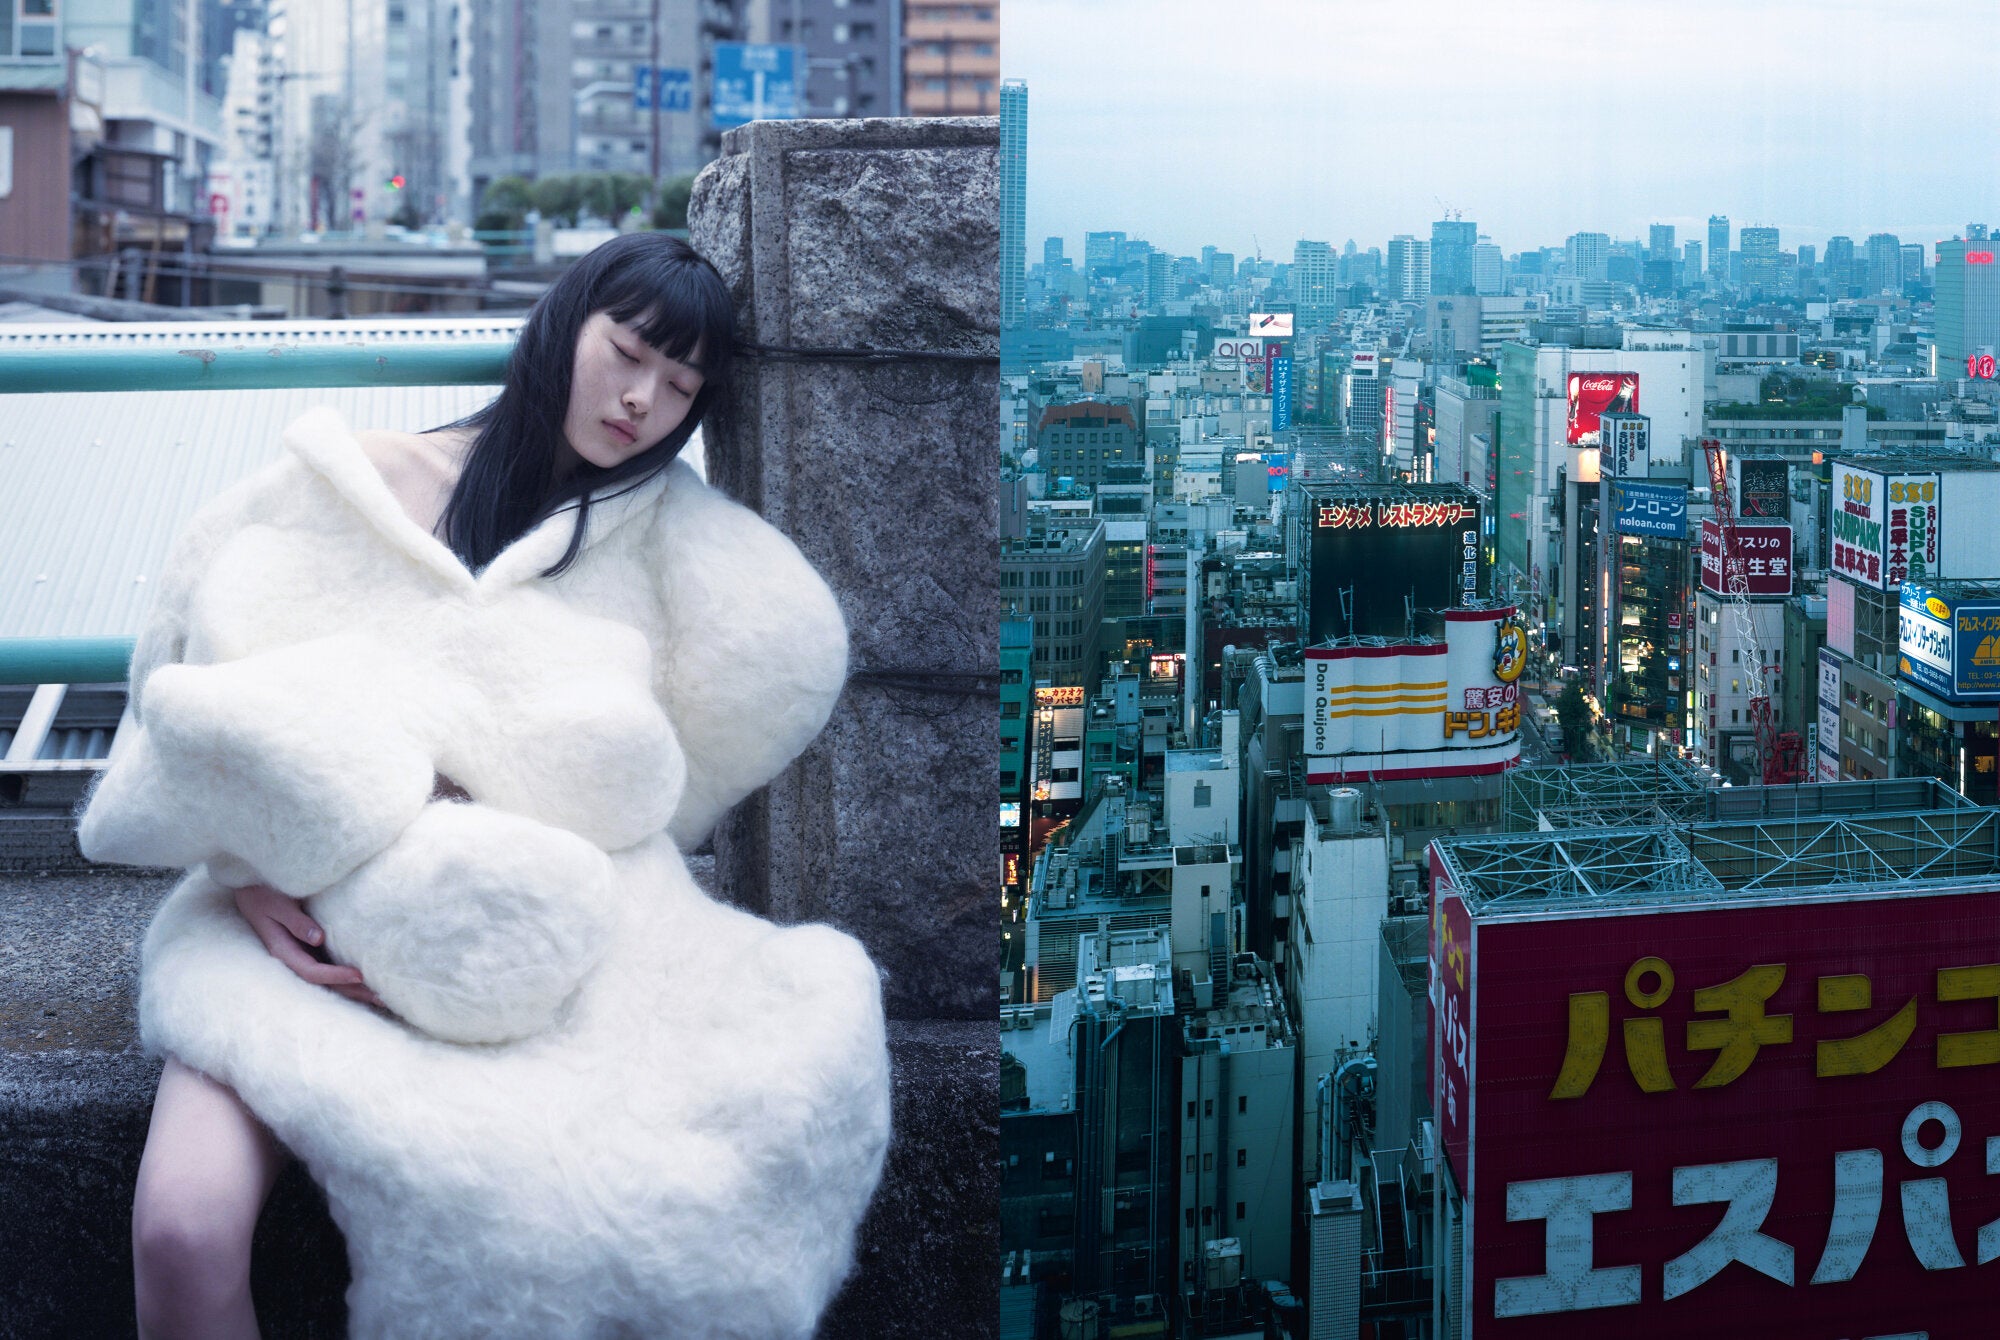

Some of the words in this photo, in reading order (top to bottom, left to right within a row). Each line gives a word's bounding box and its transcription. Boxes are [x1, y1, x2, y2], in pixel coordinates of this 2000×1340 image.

[1618, 431, 1629, 476] SUNPARK
[1318, 504, 1373, 529] エンタメ
[1378, 503, 1475, 529] レストランタワー
[1620, 517, 1676, 531] noloan.com
[1625, 499, 1685, 517] ノーローン
[1833, 508, 1882, 554] SUNPARK
[1909, 505, 1926, 582] SUNPAR
[1926, 505, 1936, 564] SHINJUKU
[1052, 688, 1084, 697] カラオケ
[1316, 663, 1328, 691] Don
[1464, 683, 1520, 710] 驚安の
[1313, 697, 1328, 751] Quijote
[1548, 955, 2000, 1101] パチンコ
[1494, 1100, 2000, 1320] エスパ
